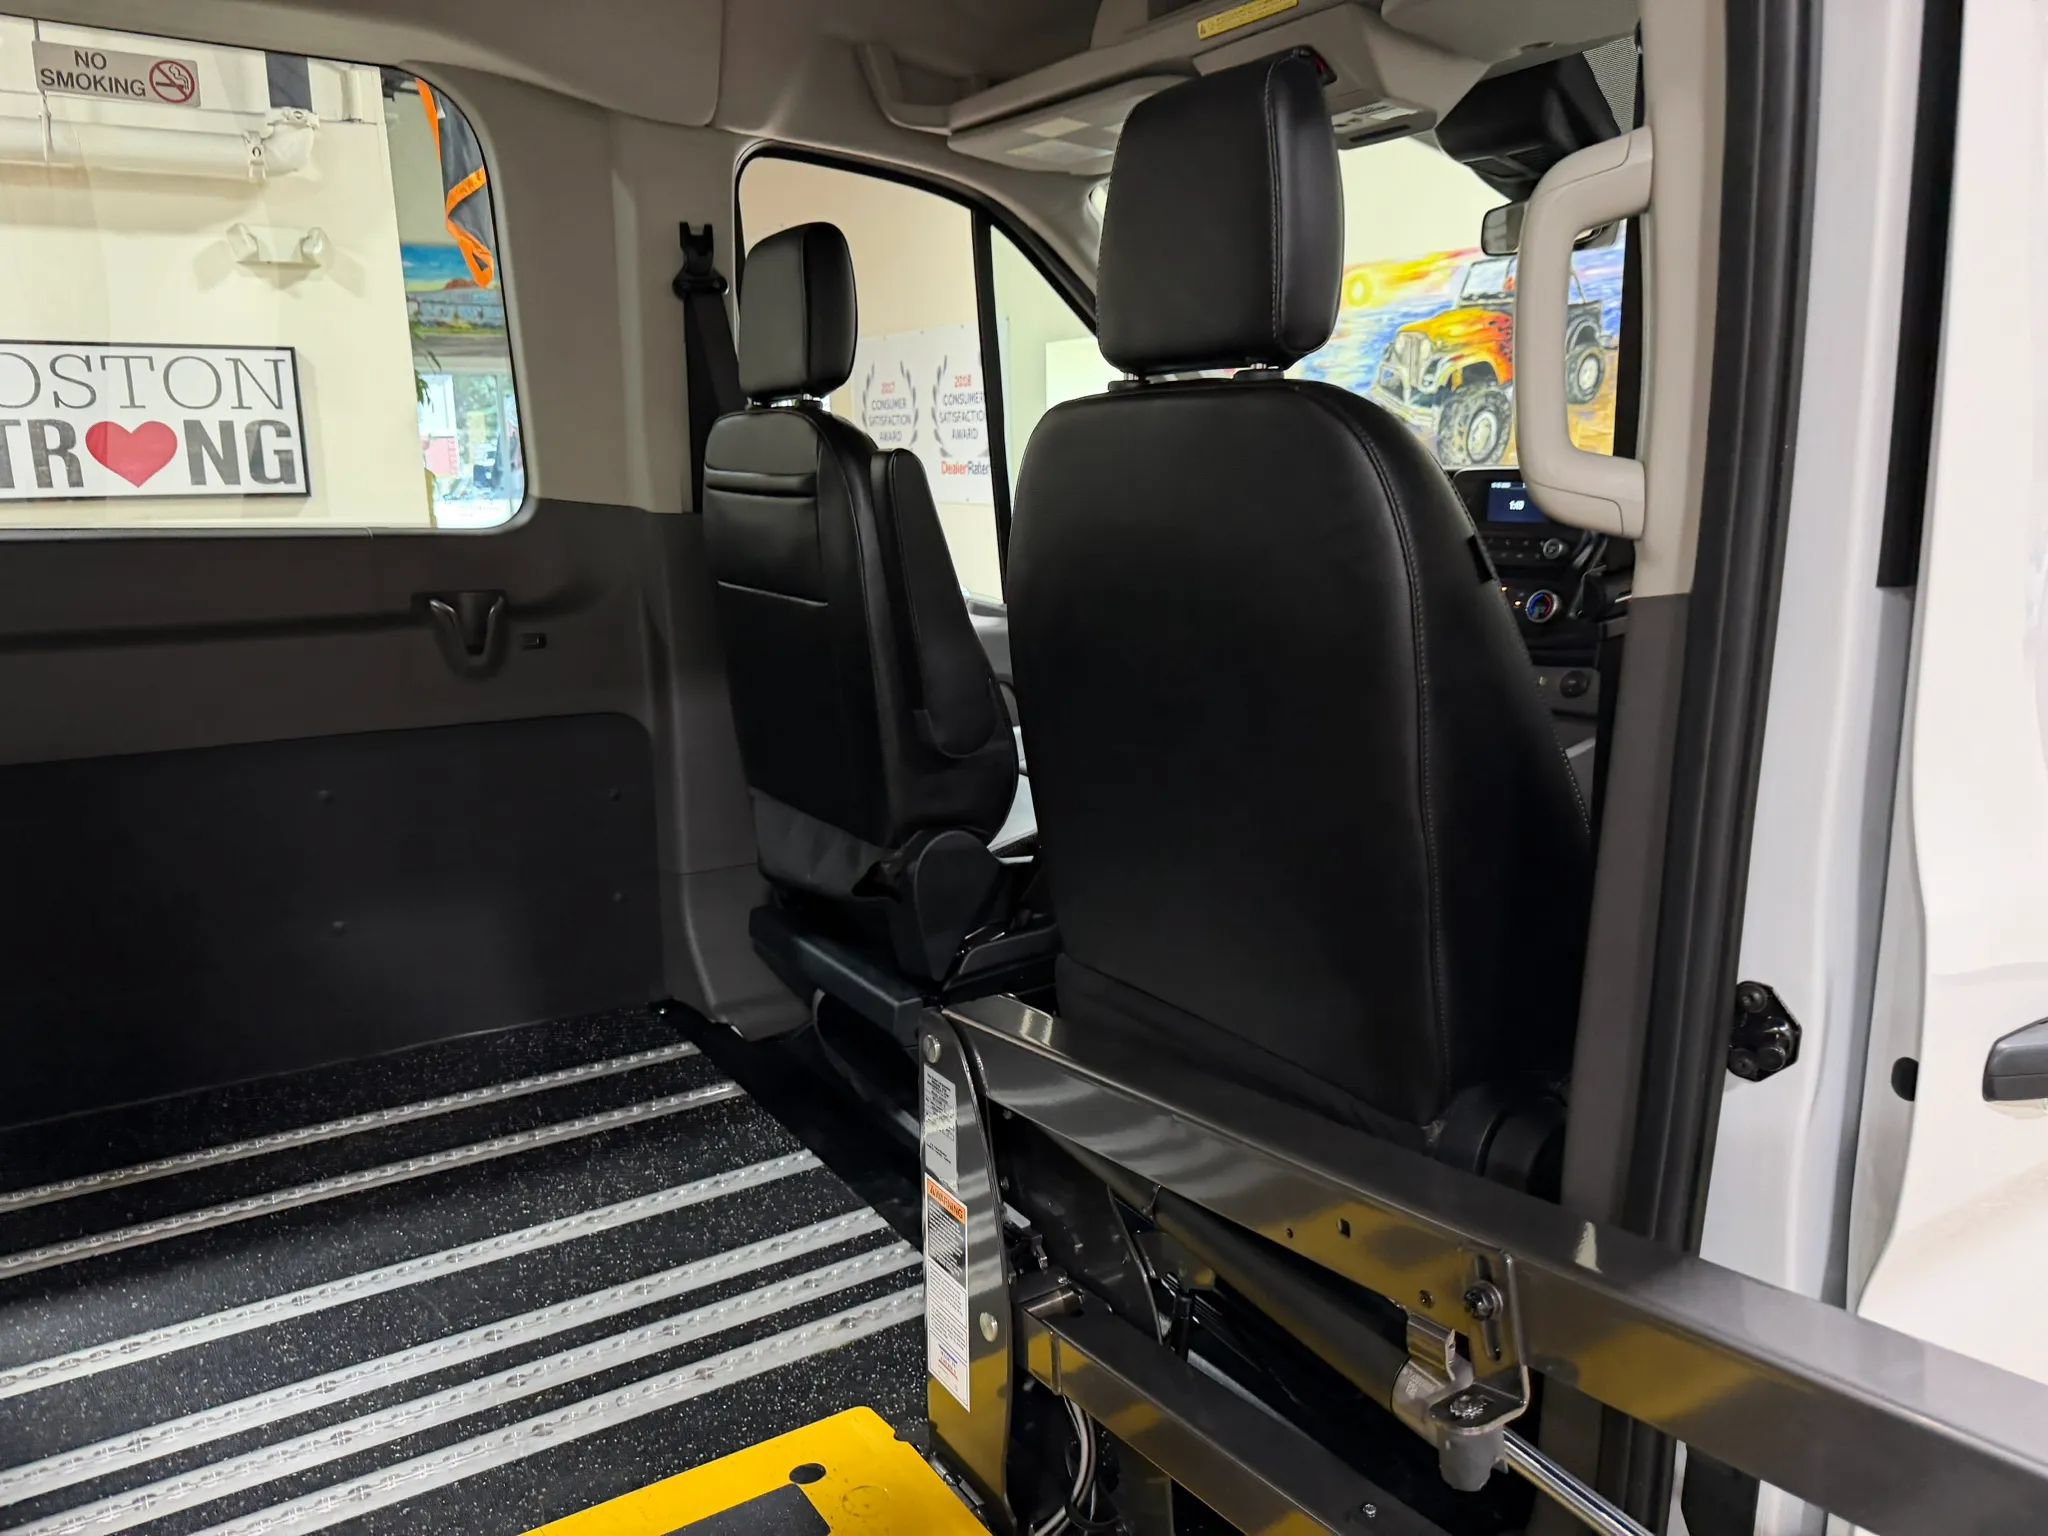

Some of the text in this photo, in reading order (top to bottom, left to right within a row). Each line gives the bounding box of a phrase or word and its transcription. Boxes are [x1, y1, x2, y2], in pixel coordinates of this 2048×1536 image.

[74, 50, 107, 70] NO
[40, 68, 147, 97] SMOKING
[872, 398, 907, 411] CONSUMER
[939, 409, 985, 424] SATISFACTIO
[952, 427, 979, 441] AWARD
[935, 1190, 963, 1219] WARNING
